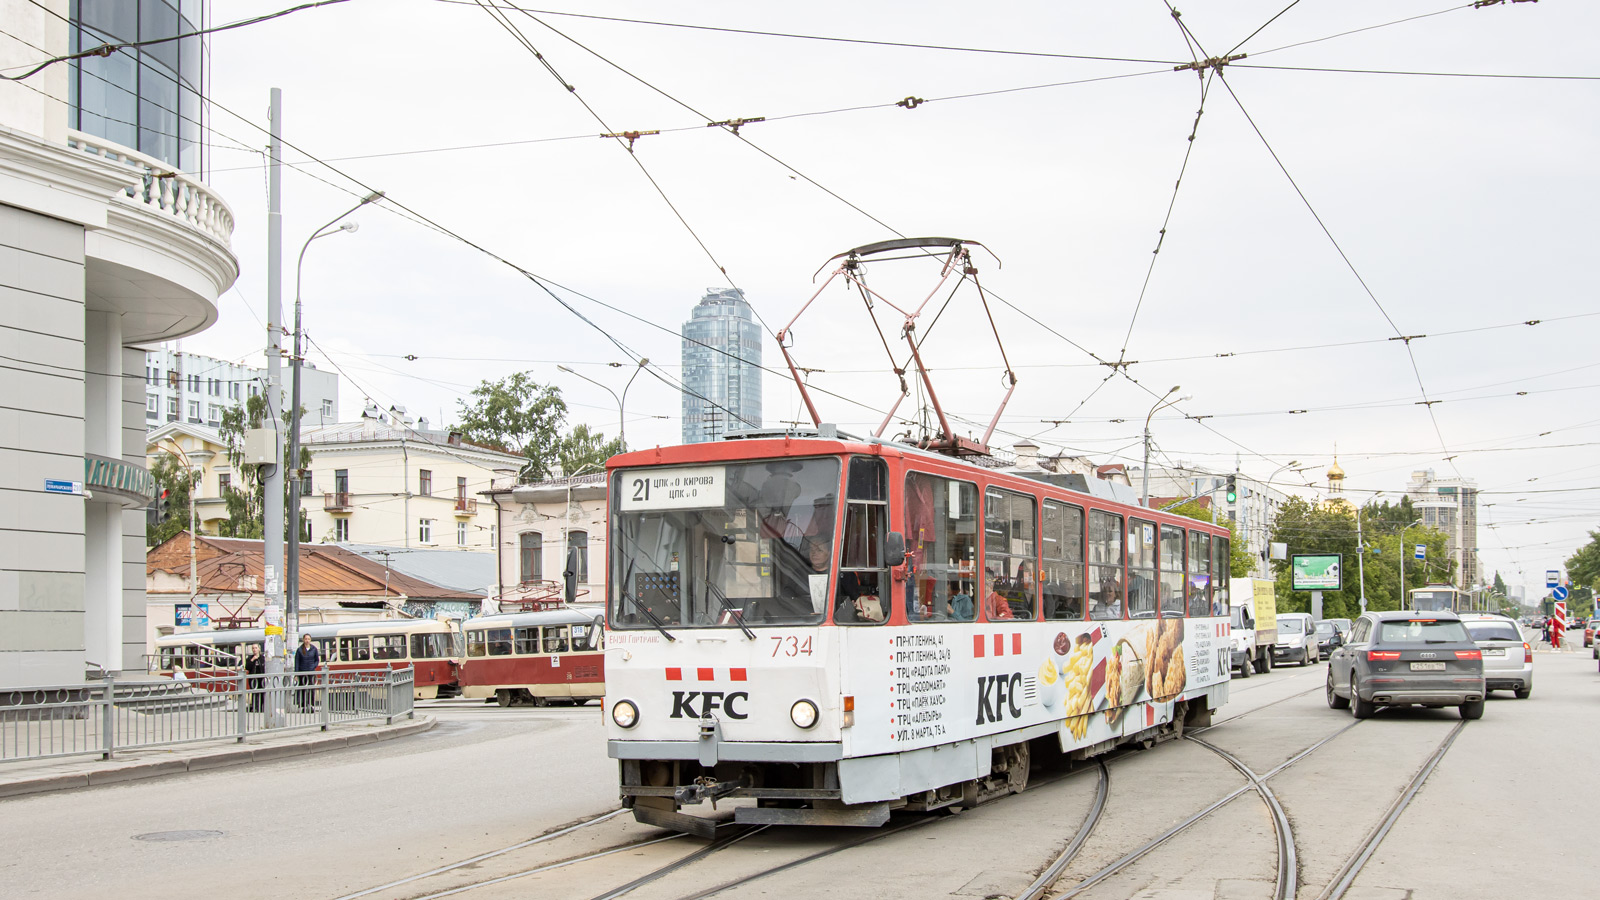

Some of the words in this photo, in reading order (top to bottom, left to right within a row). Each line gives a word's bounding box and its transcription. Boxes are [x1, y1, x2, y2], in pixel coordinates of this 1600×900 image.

[632, 478, 650, 501] 21
[653, 478, 669, 489] ЦПК
[683, 476, 714, 486] КИРОВА
[669, 489, 685, 500] ЦПК
[770, 635, 813, 658] 734
[896, 635, 914, 647] ПР-КТ
[915, 635, 937, 648] ЛЕНИНА,
[896, 651, 914, 663] ПР-КТ
[915, 650, 938, 663] ЛЕНИНА,
[896, 667, 910, 680] ТРЦ
[896, 682, 910, 695] ТРЦ
[896, 698, 911, 711] ТРЦ
[976, 671, 1022, 726] KFC
[669, 691, 749, 720] KFC
[897, 714, 911, 726] ТРЦ
[897, 729, 910, 742] УЛ.
[911, 728, 915, 740] 8
[916, 726, 935, 739] МАРТА,
[935, 724, 941, 735] 75
